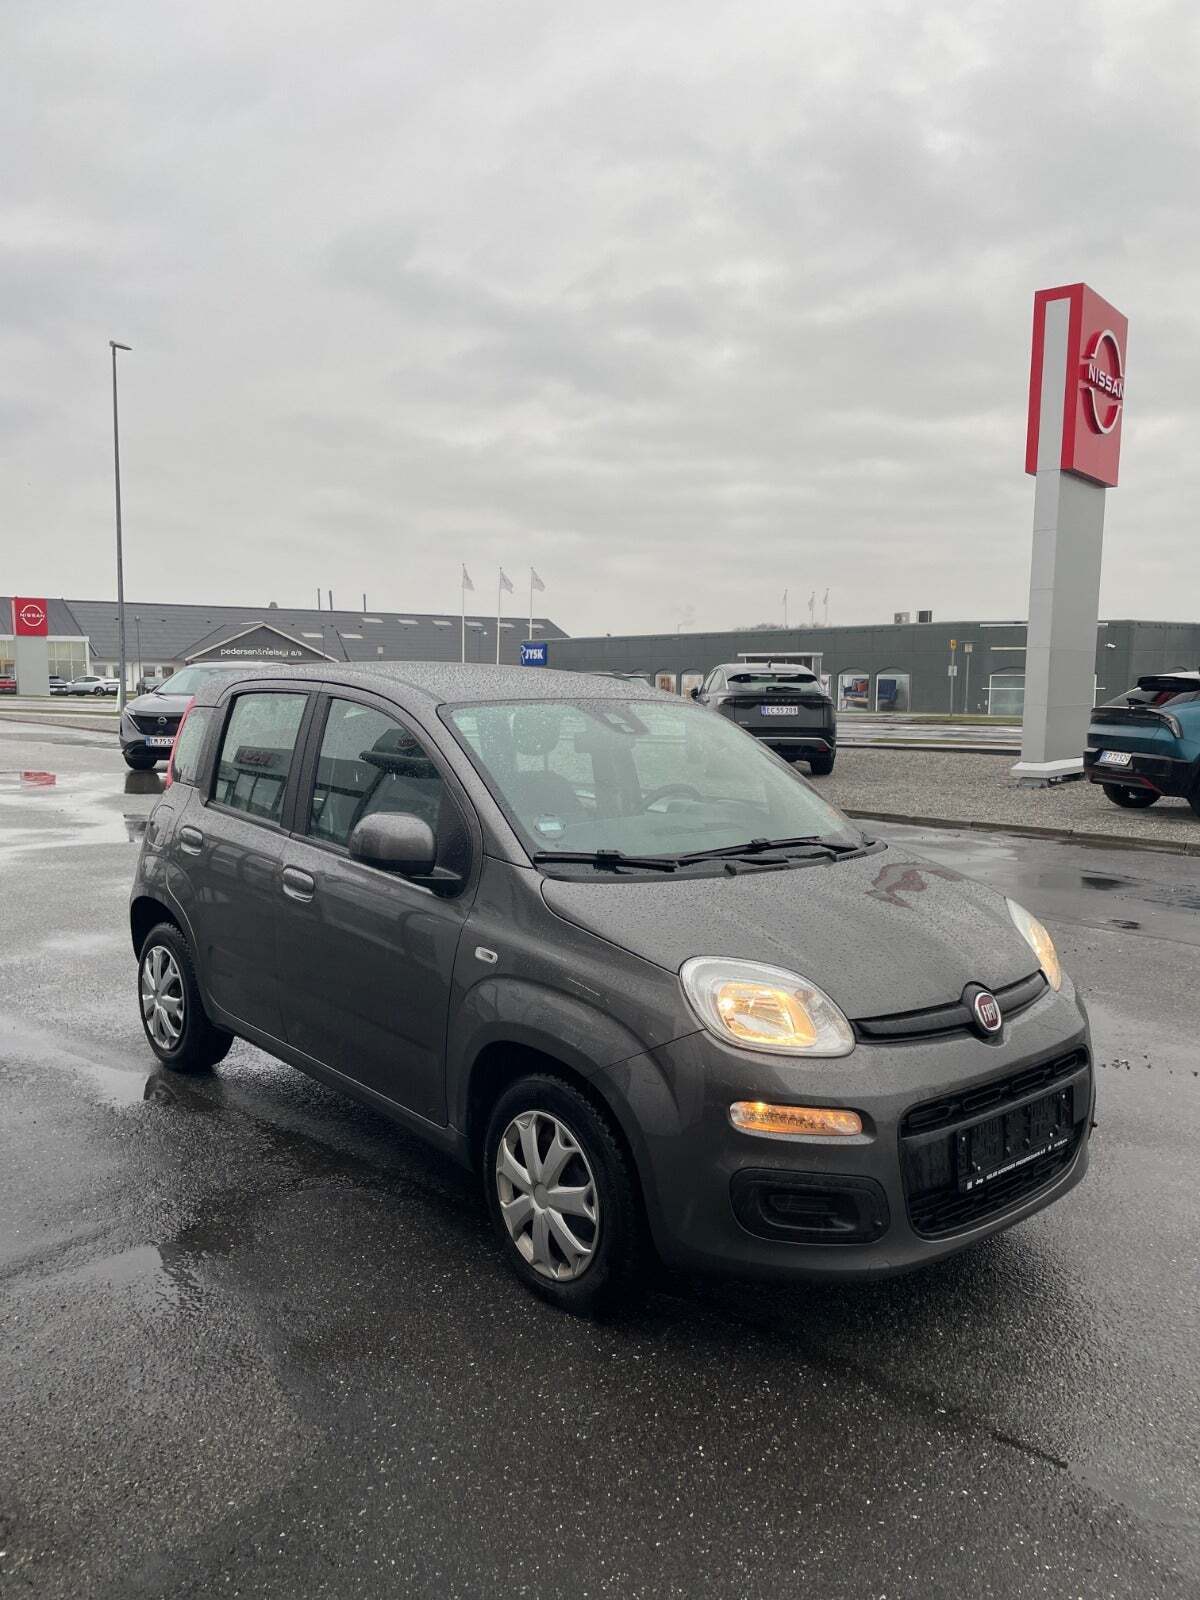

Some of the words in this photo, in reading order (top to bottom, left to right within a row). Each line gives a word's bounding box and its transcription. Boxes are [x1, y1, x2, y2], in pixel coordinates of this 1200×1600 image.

[1088, 363, 1124, 399] NISSAN
[525, 648, 544, 660] JYSK
[981, 1002, 997, 1022] FIAT
